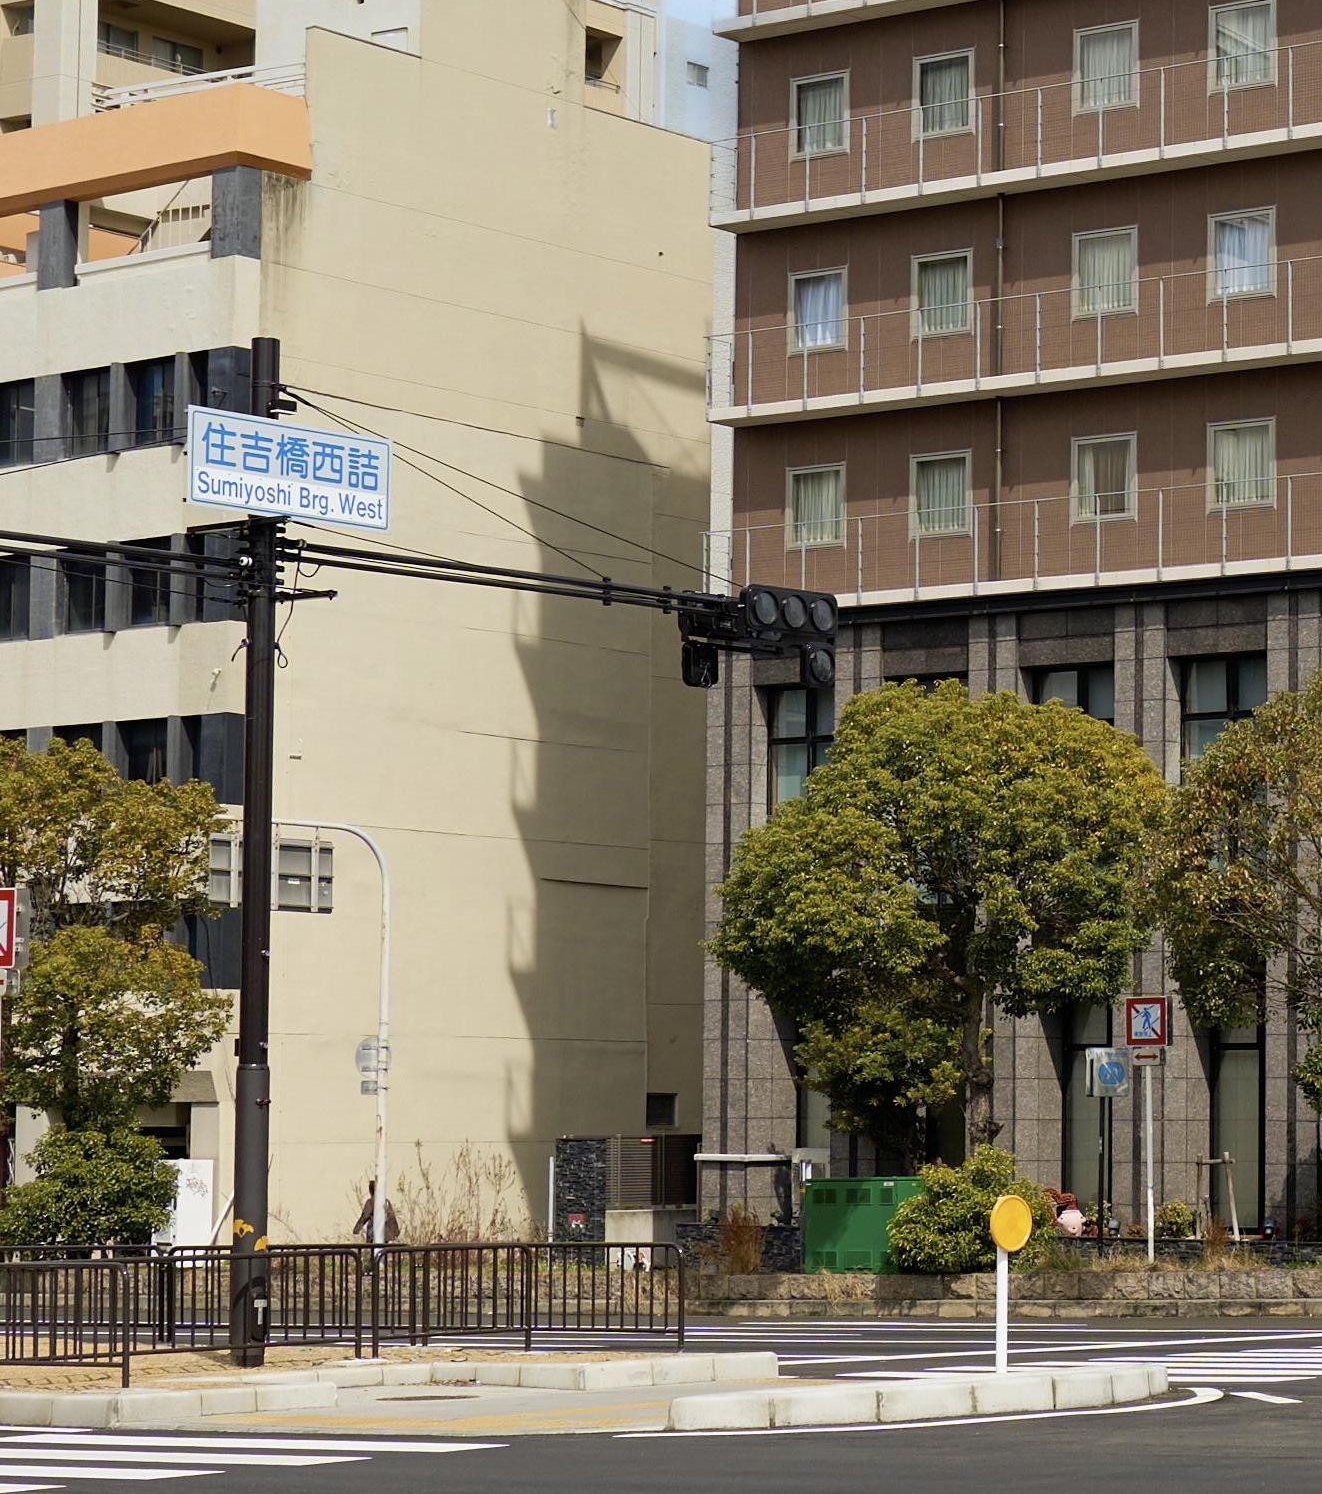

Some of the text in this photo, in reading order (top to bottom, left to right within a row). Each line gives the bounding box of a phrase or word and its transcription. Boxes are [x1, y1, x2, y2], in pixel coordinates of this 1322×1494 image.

[201, 421, 379, 492] 住吉橋西詰
[197, 470, 383, 521] Sumiyoshi Brg. West
